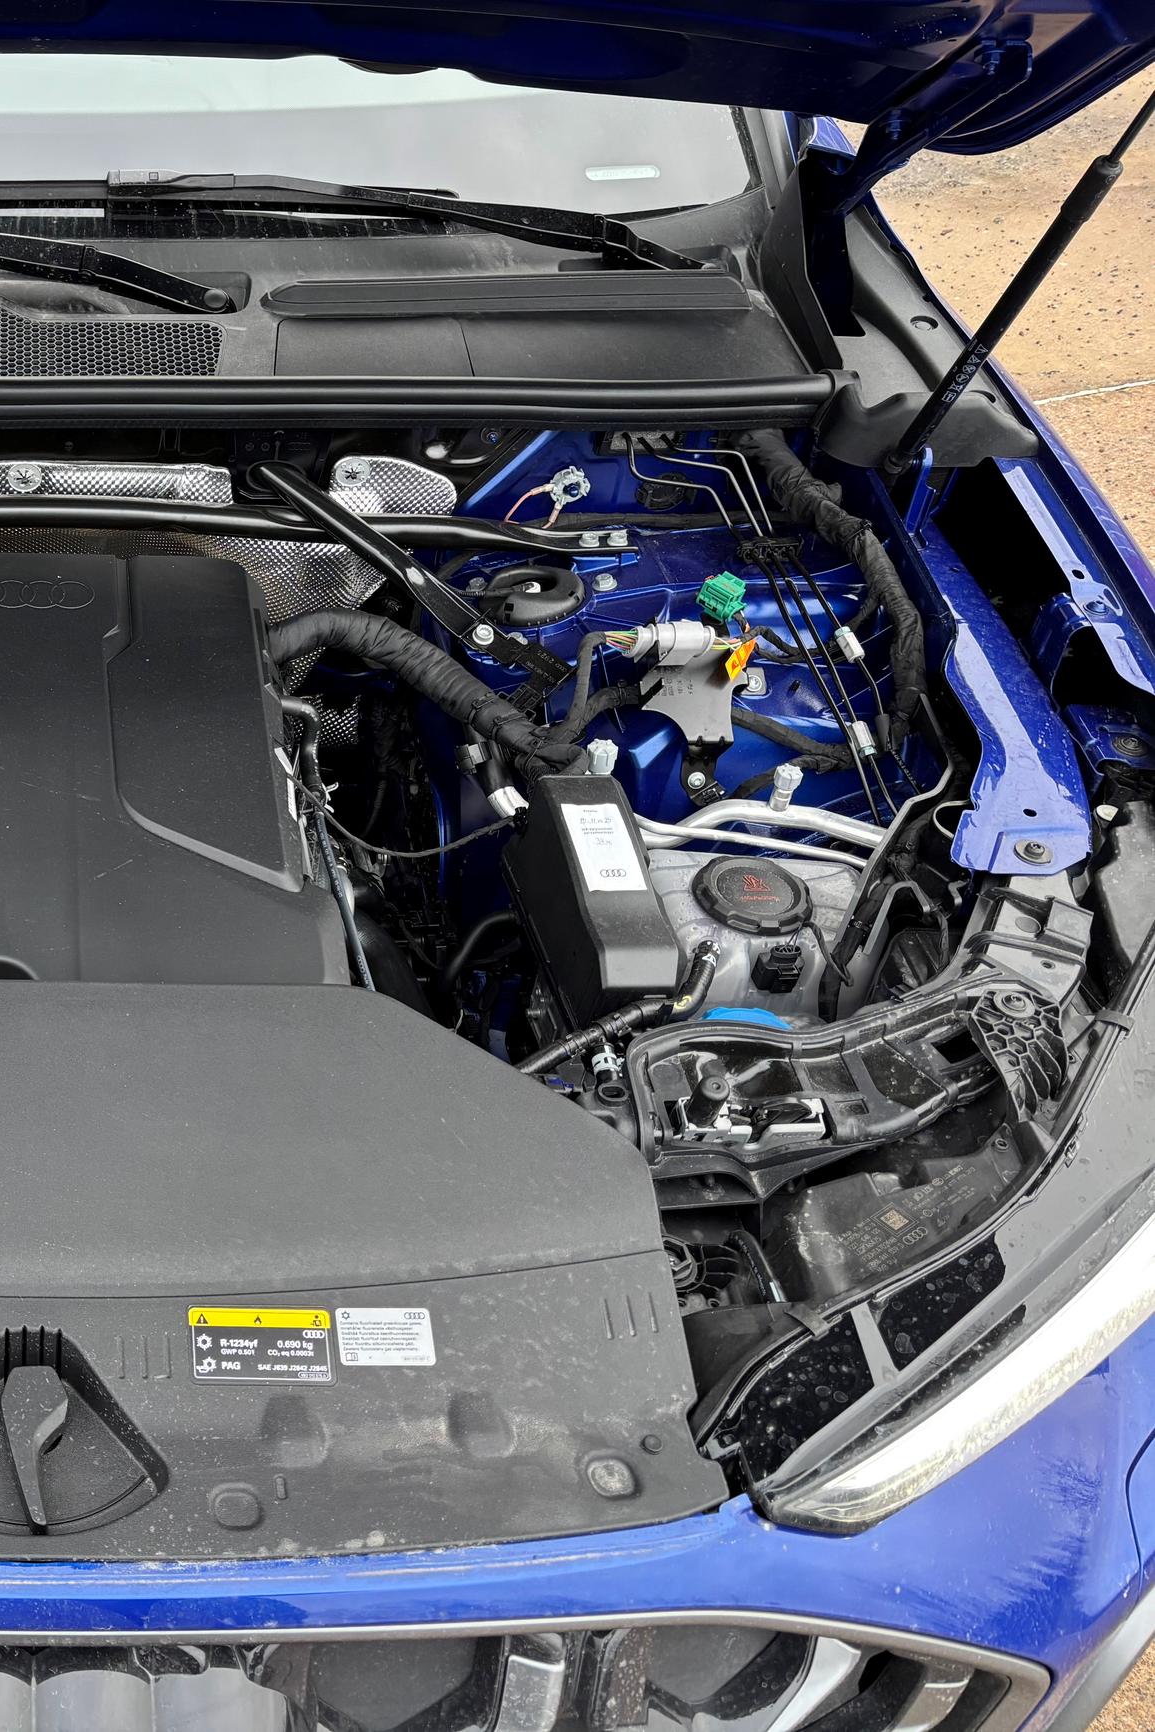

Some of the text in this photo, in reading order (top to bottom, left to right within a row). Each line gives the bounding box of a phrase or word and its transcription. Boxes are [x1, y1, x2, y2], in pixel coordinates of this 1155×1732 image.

[220, 1339, 313, 1350] R-1234yf 0.690 kg
[221, 1362, 241, 1370] PAG
